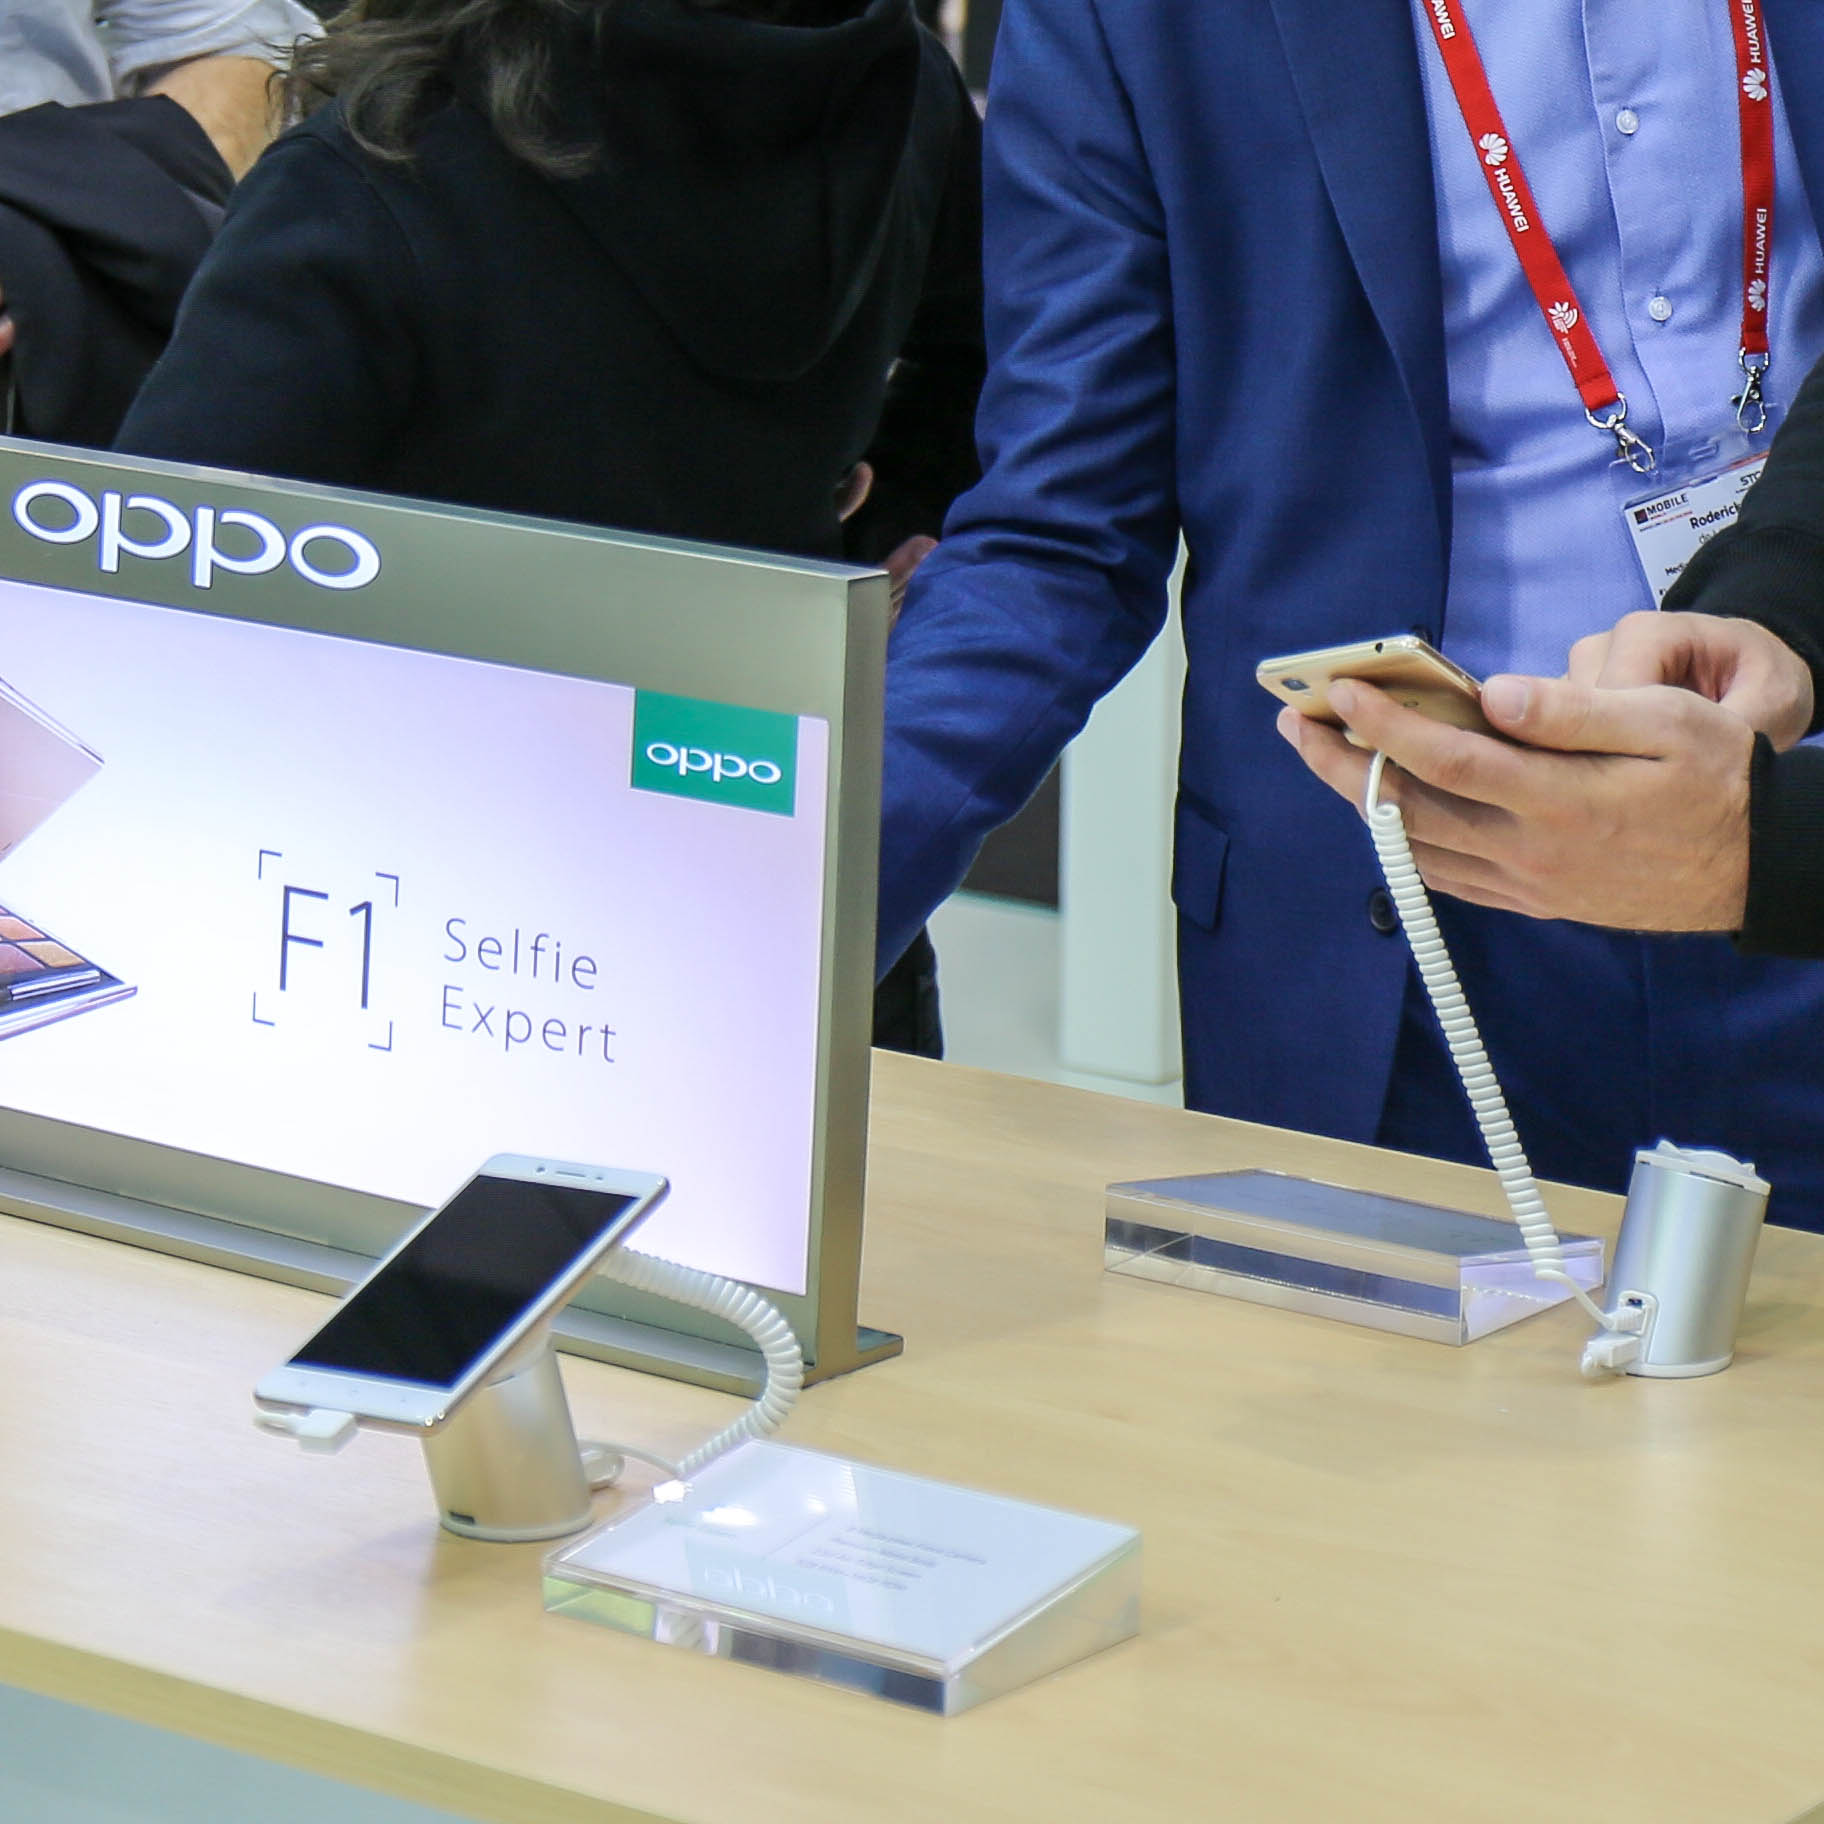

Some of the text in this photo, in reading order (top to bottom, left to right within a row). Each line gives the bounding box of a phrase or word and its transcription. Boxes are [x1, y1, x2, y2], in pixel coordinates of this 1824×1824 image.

[1494, 167, 1530, 234] HUAWEI
[1755, 207, 1768, 274] HUAWEI
[12, 480, 381, 591] oppo
[1647, 493, 1688, 516] MOBILE
[646, 742, 782, 784] oppo
[279, 885, 373, 1010] F1
[443, 917, 598, 989] Selfie
[441, 984, 617, 1063] Expert
